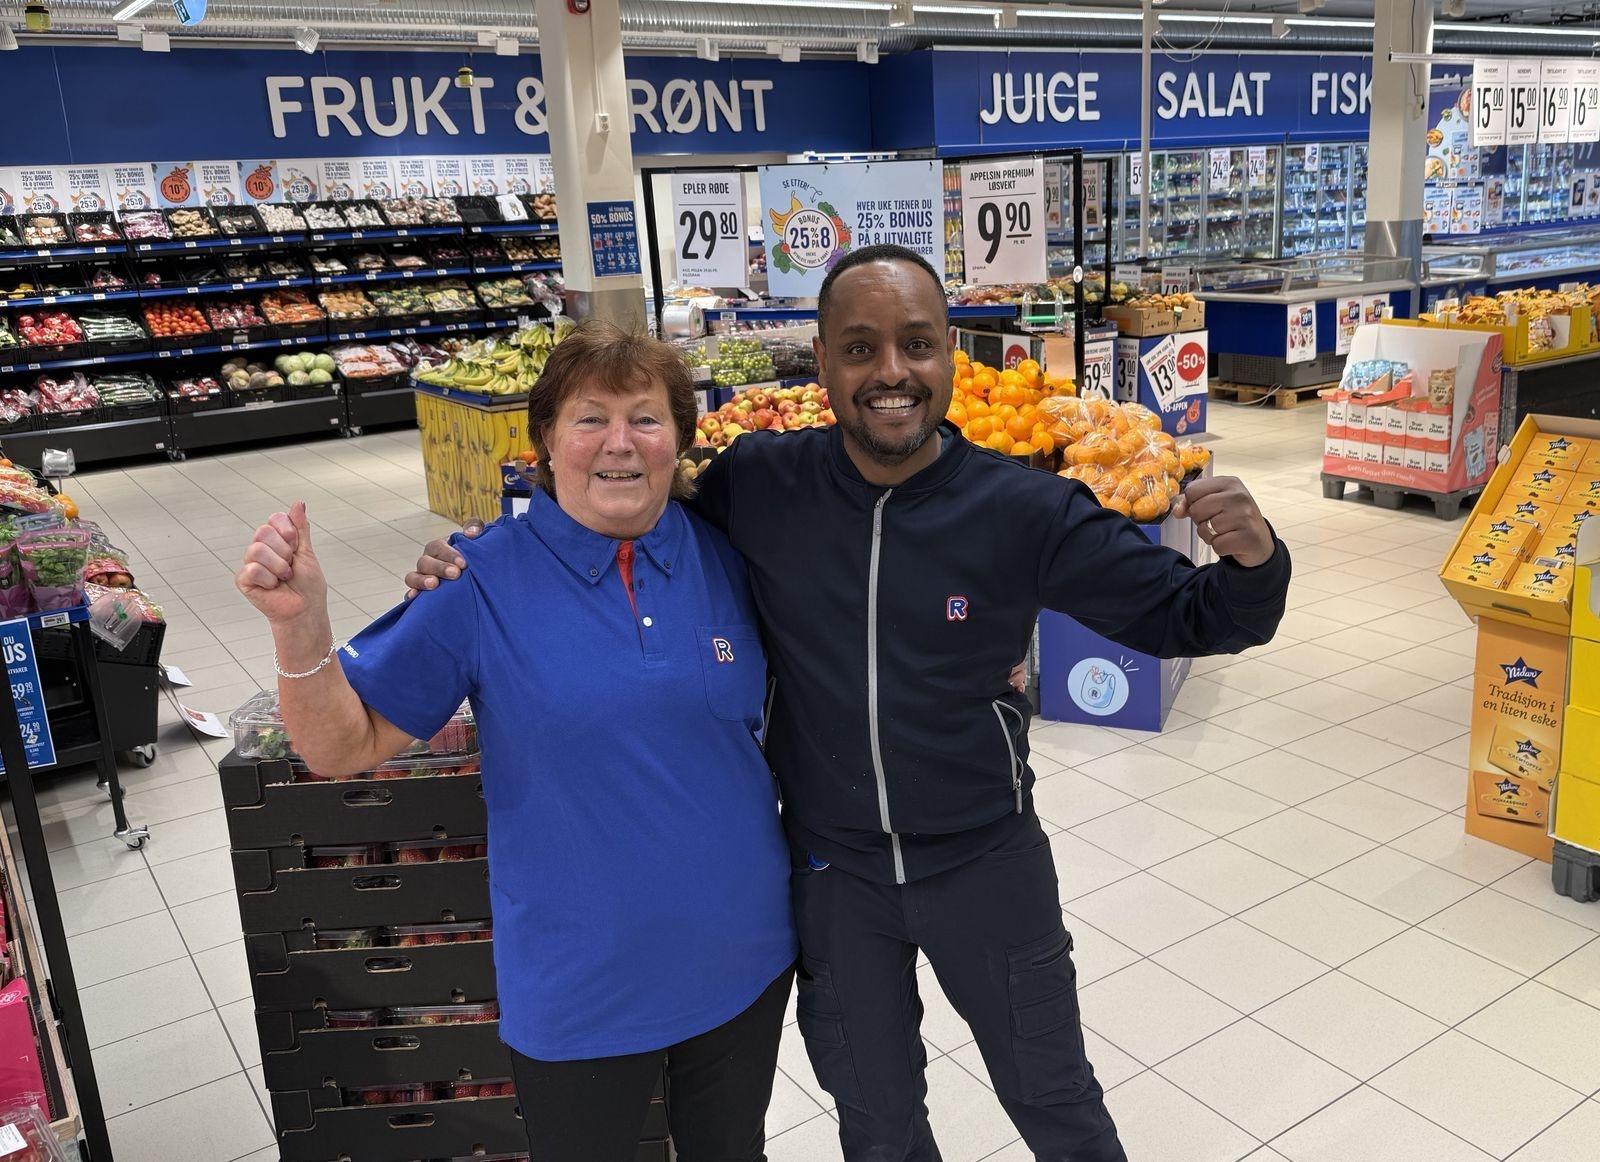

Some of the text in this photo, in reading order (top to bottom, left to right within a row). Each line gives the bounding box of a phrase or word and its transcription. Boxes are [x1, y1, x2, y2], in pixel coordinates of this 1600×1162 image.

[980, 71, 1101, 124] JUICE
[1157, 71, 1271, 119] SALAT
[265, 76, 774, 138] FRUKT & RØNT
[1477, 87, 1504, 128] 15 00
[1510, 87, 1537, 128] 15 00
[1543, 87, 1569, 126] 16 90
[1574, 87, 1598, 125] 16 90
[970, 168, 1034, 181] APPELSIN PREMIUM
[682, 182, 730, 195] EPLER RØDE
[782, 178, 810, 191] SE ETTER!
[988, 180, 1016, 190] LØSVEKT
[856, 199, 932, 211] HVER UKE TJENER DU
[591, 211, 634, 224] 50% BONUS
[797, 214, 821, 225] BONUS
[857, 210, 933, 229] 25% BONUS
[679, 210, 738, 260] 29 80
[789, 227, 810, 249] 25
[820, 226, 831, 249] 8
[858, 229, 933, 246] PÅ 8 UTVALGTE
[977, 201, 1031, 264] 9 90
[906, 246, 933, 255] TVARER
[1127, 360, 1136, 375] 00
[1177, 353, 1205, 370] -50%
[1084, 361, 1111, 391] 59 90
[1151, 364, 1173, 396] 13
[945, 595, 969, 621] R
[3, 636, 15, 646] DU
[711, 637, 735, 663] R
[3, 643, 27, 664] US
[1505, 665, 1537, 678] Nidar
[11, 683, 25, 699] 59
[1091, 689, 1098, 697] R
[1488, 683, 1556, 713] Tradisjon i
[1483, 699, 1557, 728] en liten eske
[20, 724, 32, 738] 24
[1518, 743, 1538, 754] Nidar
[1500, 782, 1518, 791] Nidar
